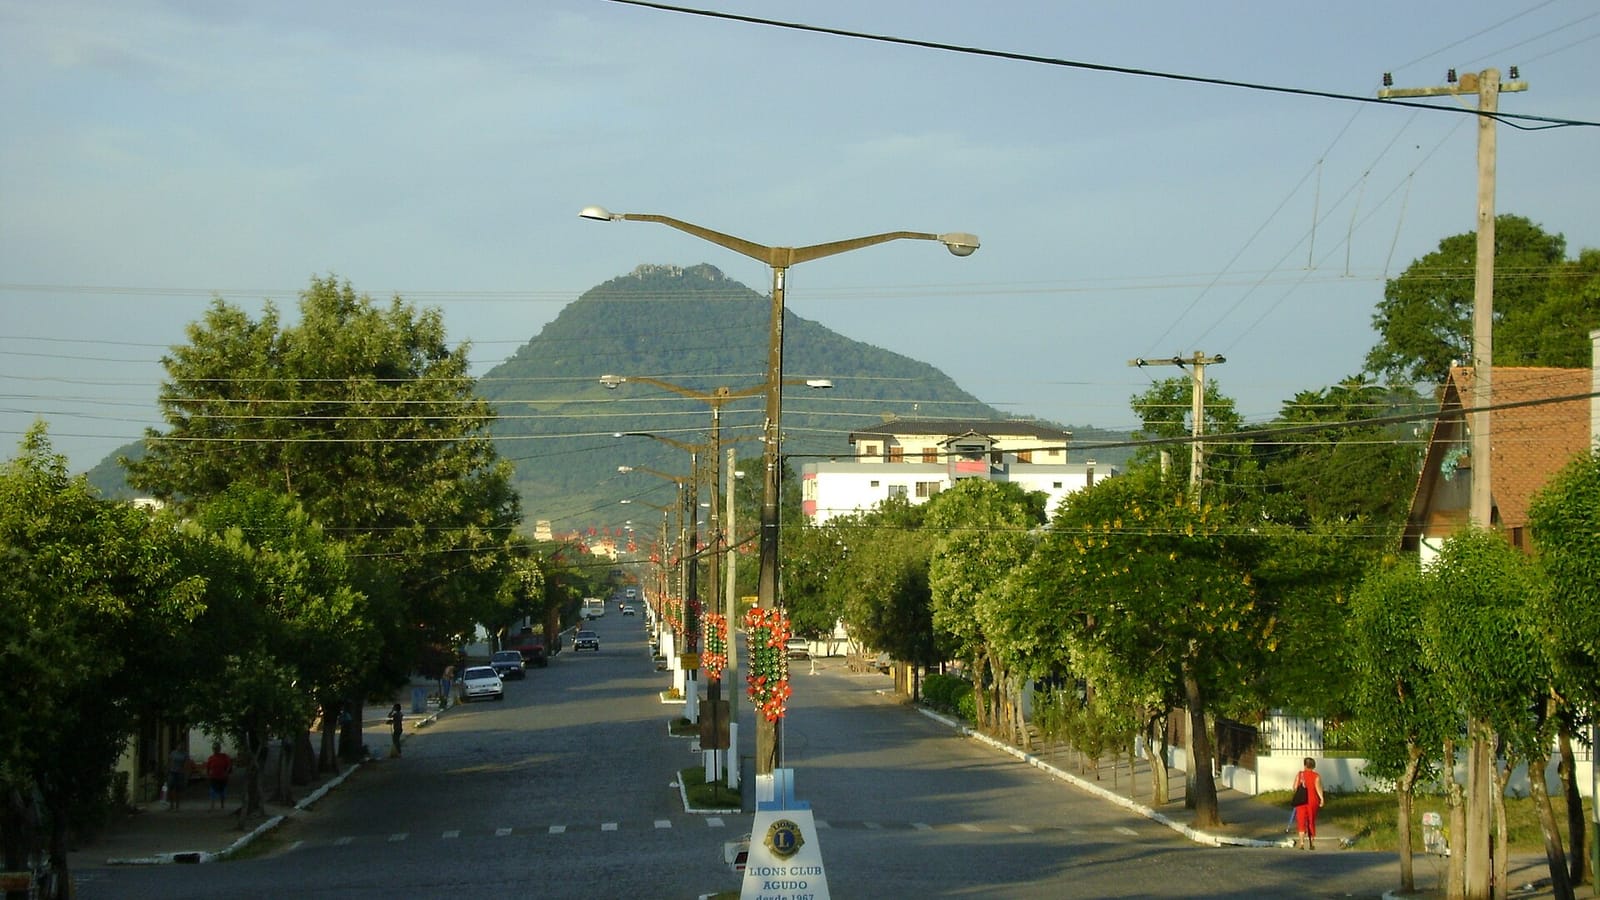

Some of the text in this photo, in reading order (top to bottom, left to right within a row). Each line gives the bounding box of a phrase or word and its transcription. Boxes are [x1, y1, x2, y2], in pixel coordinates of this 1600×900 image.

[772, 822, 795, 831] LIONS
[777, 832, 789, 847] L
[749, 866, 822, 876] LIONS CLUB
[763, 881, 807, 889] AGUDO
